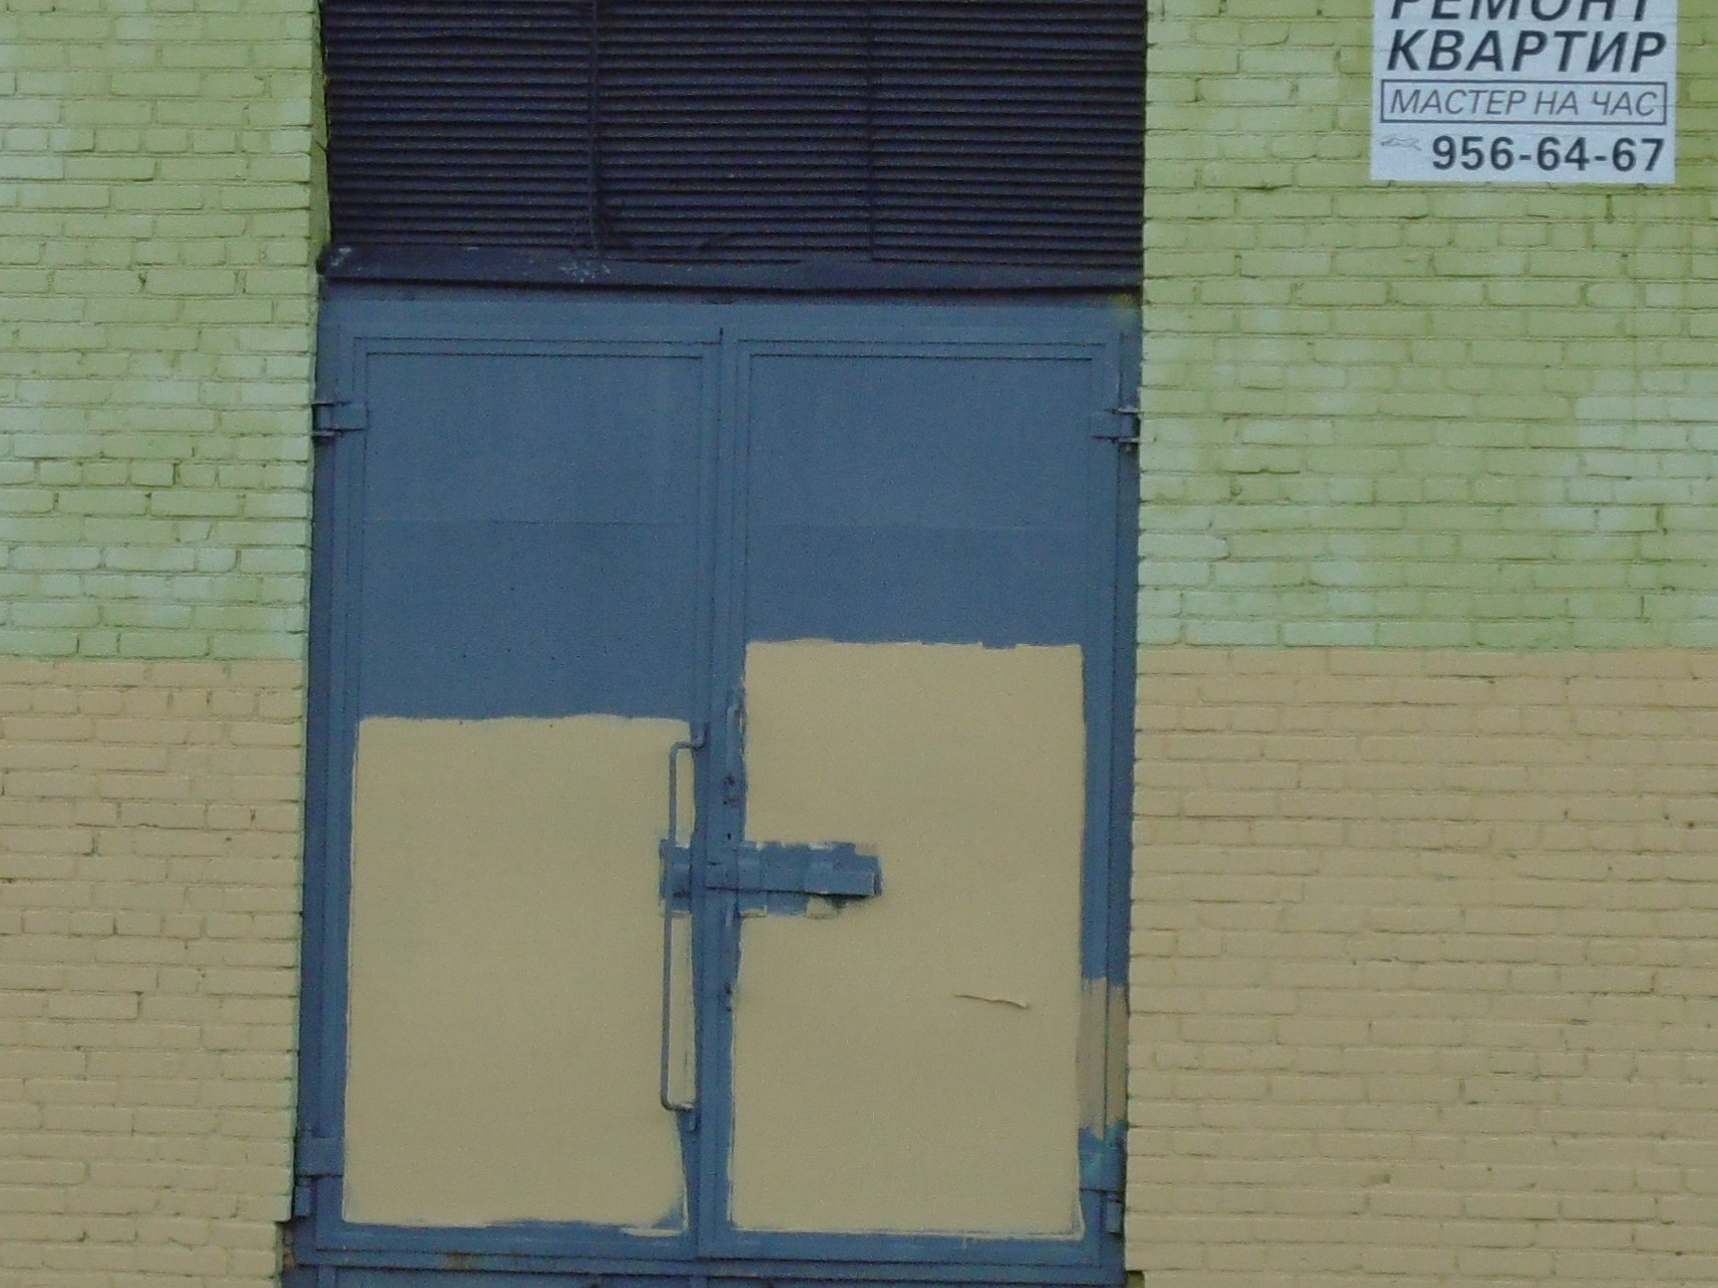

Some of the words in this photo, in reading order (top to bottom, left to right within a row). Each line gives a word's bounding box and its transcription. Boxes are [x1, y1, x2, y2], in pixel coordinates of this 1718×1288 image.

[1386, 29, 1668, 72] КВАРТИР
[1390, 89, 1526, 115] МАСТЕР
[1533, 90, 1579, 115] НА
[1592, 91, 1658, 116] ЧАС
[1432, 135, 1665, 172] 956-64-67
